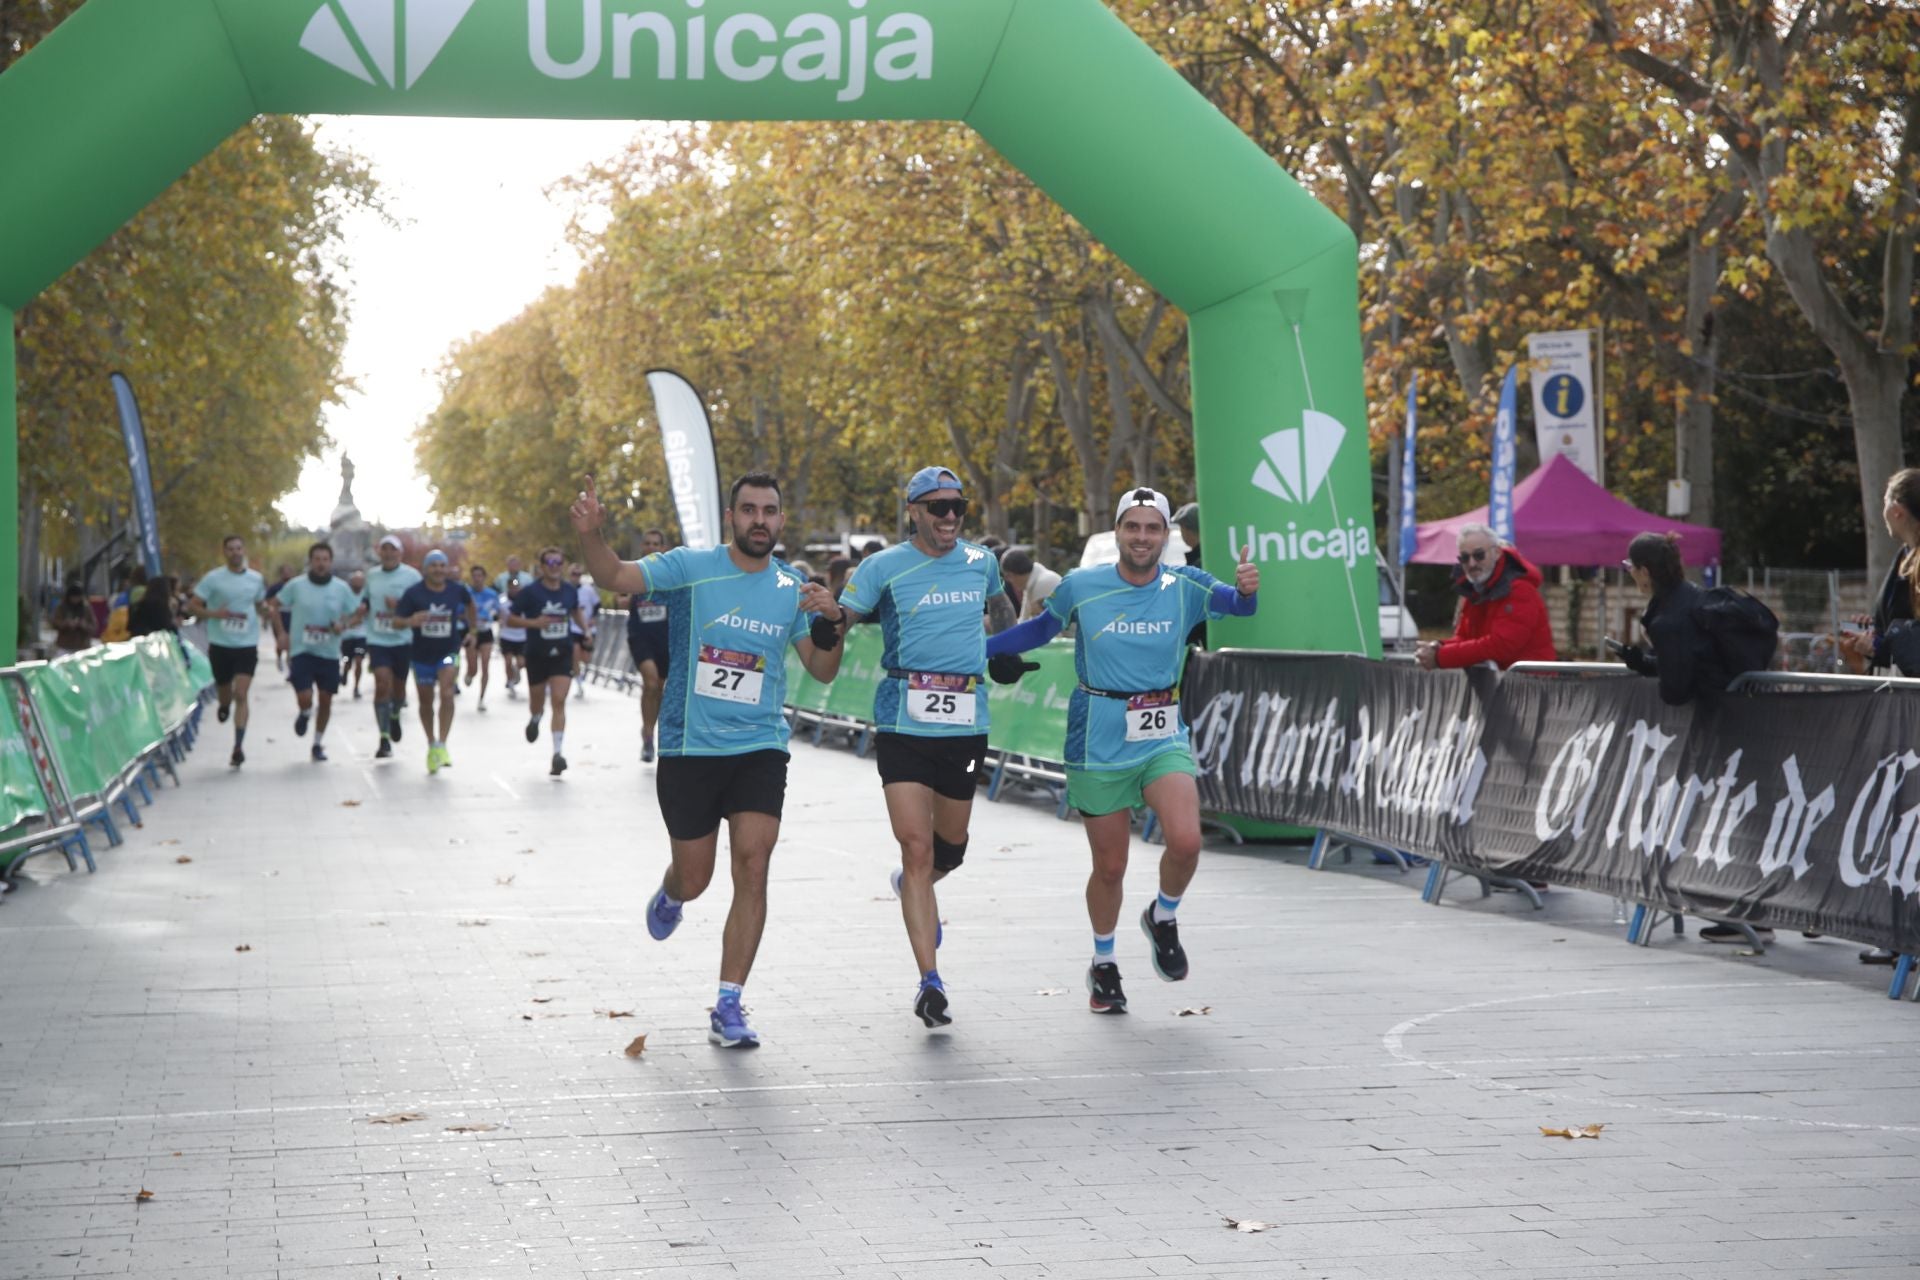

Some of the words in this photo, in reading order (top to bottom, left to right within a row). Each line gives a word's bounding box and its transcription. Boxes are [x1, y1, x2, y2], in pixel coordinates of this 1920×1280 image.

[528, 0, 934, 101] Unicaja
[1228, 518, 1370, 568] Unicaja
[917, 591, 981, 606] ADIENT
[715, 613, 784, 637] ADIENT
[1101, 621, 1172, 634] ADIENT
[711, 668, 745, 690] 27
[924, 693, 956, 714] 25
[1138, 710, 1166, 730] 26
[1241, 692, 1345, 792] Norte
[1535, 720, 1615, 843] El
[1606, 719, 1757, 873] Norte
[1757, 754, 1835, 881] de
